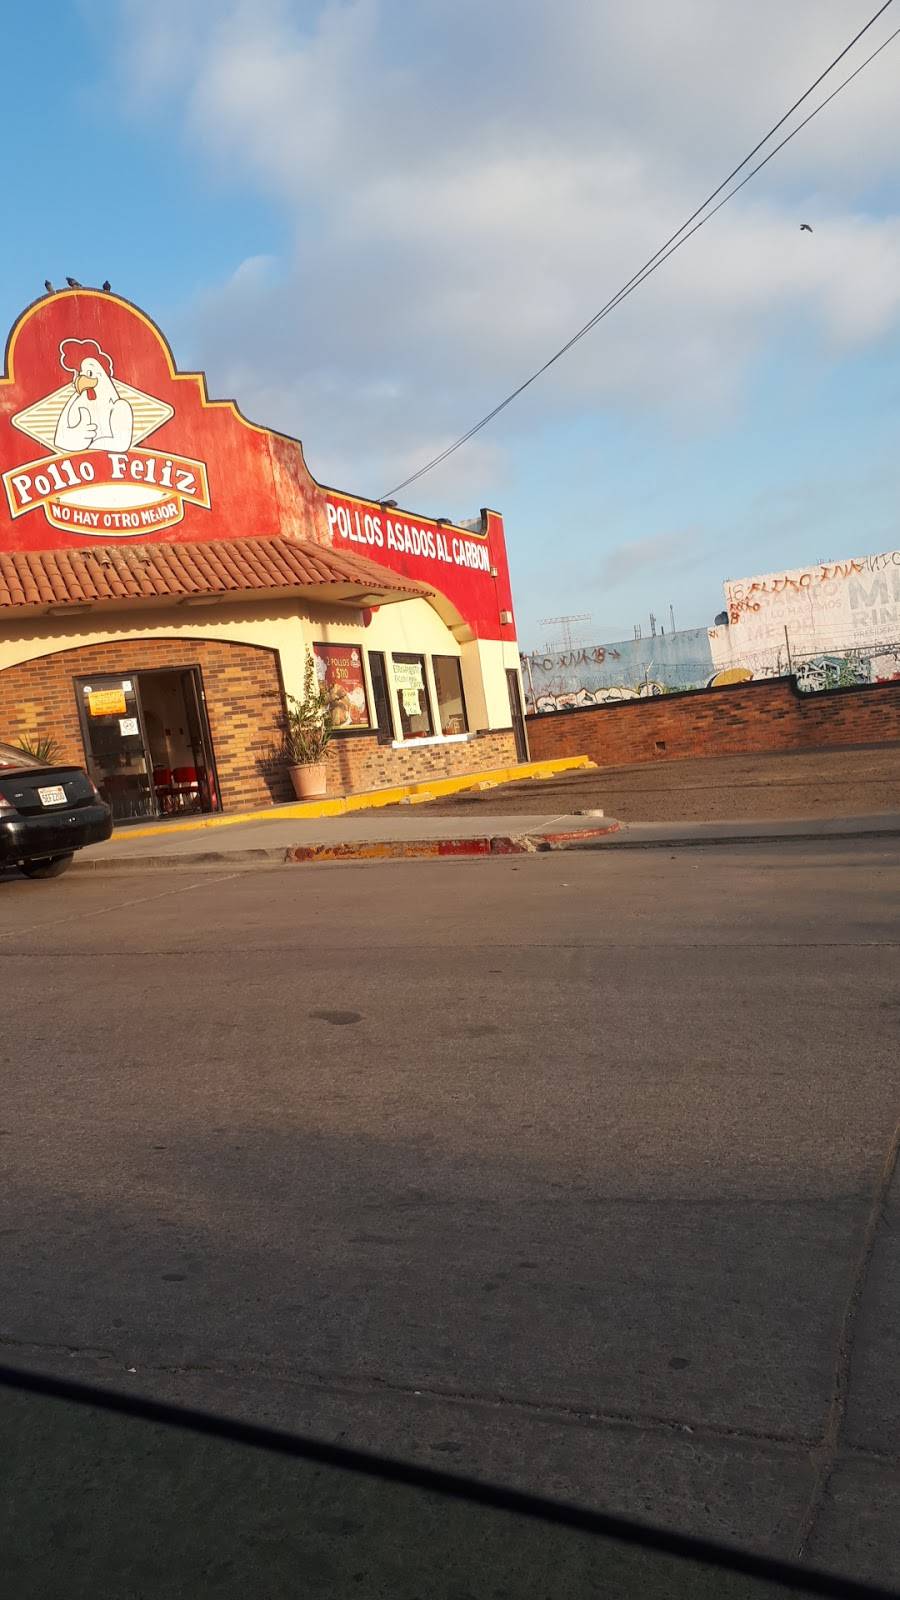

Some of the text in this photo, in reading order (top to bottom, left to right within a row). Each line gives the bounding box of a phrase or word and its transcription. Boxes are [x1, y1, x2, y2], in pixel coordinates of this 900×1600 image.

[12, 453, 197, 504] Pollo Feliz
[52, 503, 178, 527] NO HAY OTRO MEJOR
[326, 503, 490, 572] POLLOS ASADOS AL CARBON
[330, 658, 350, 667] POLLOS
